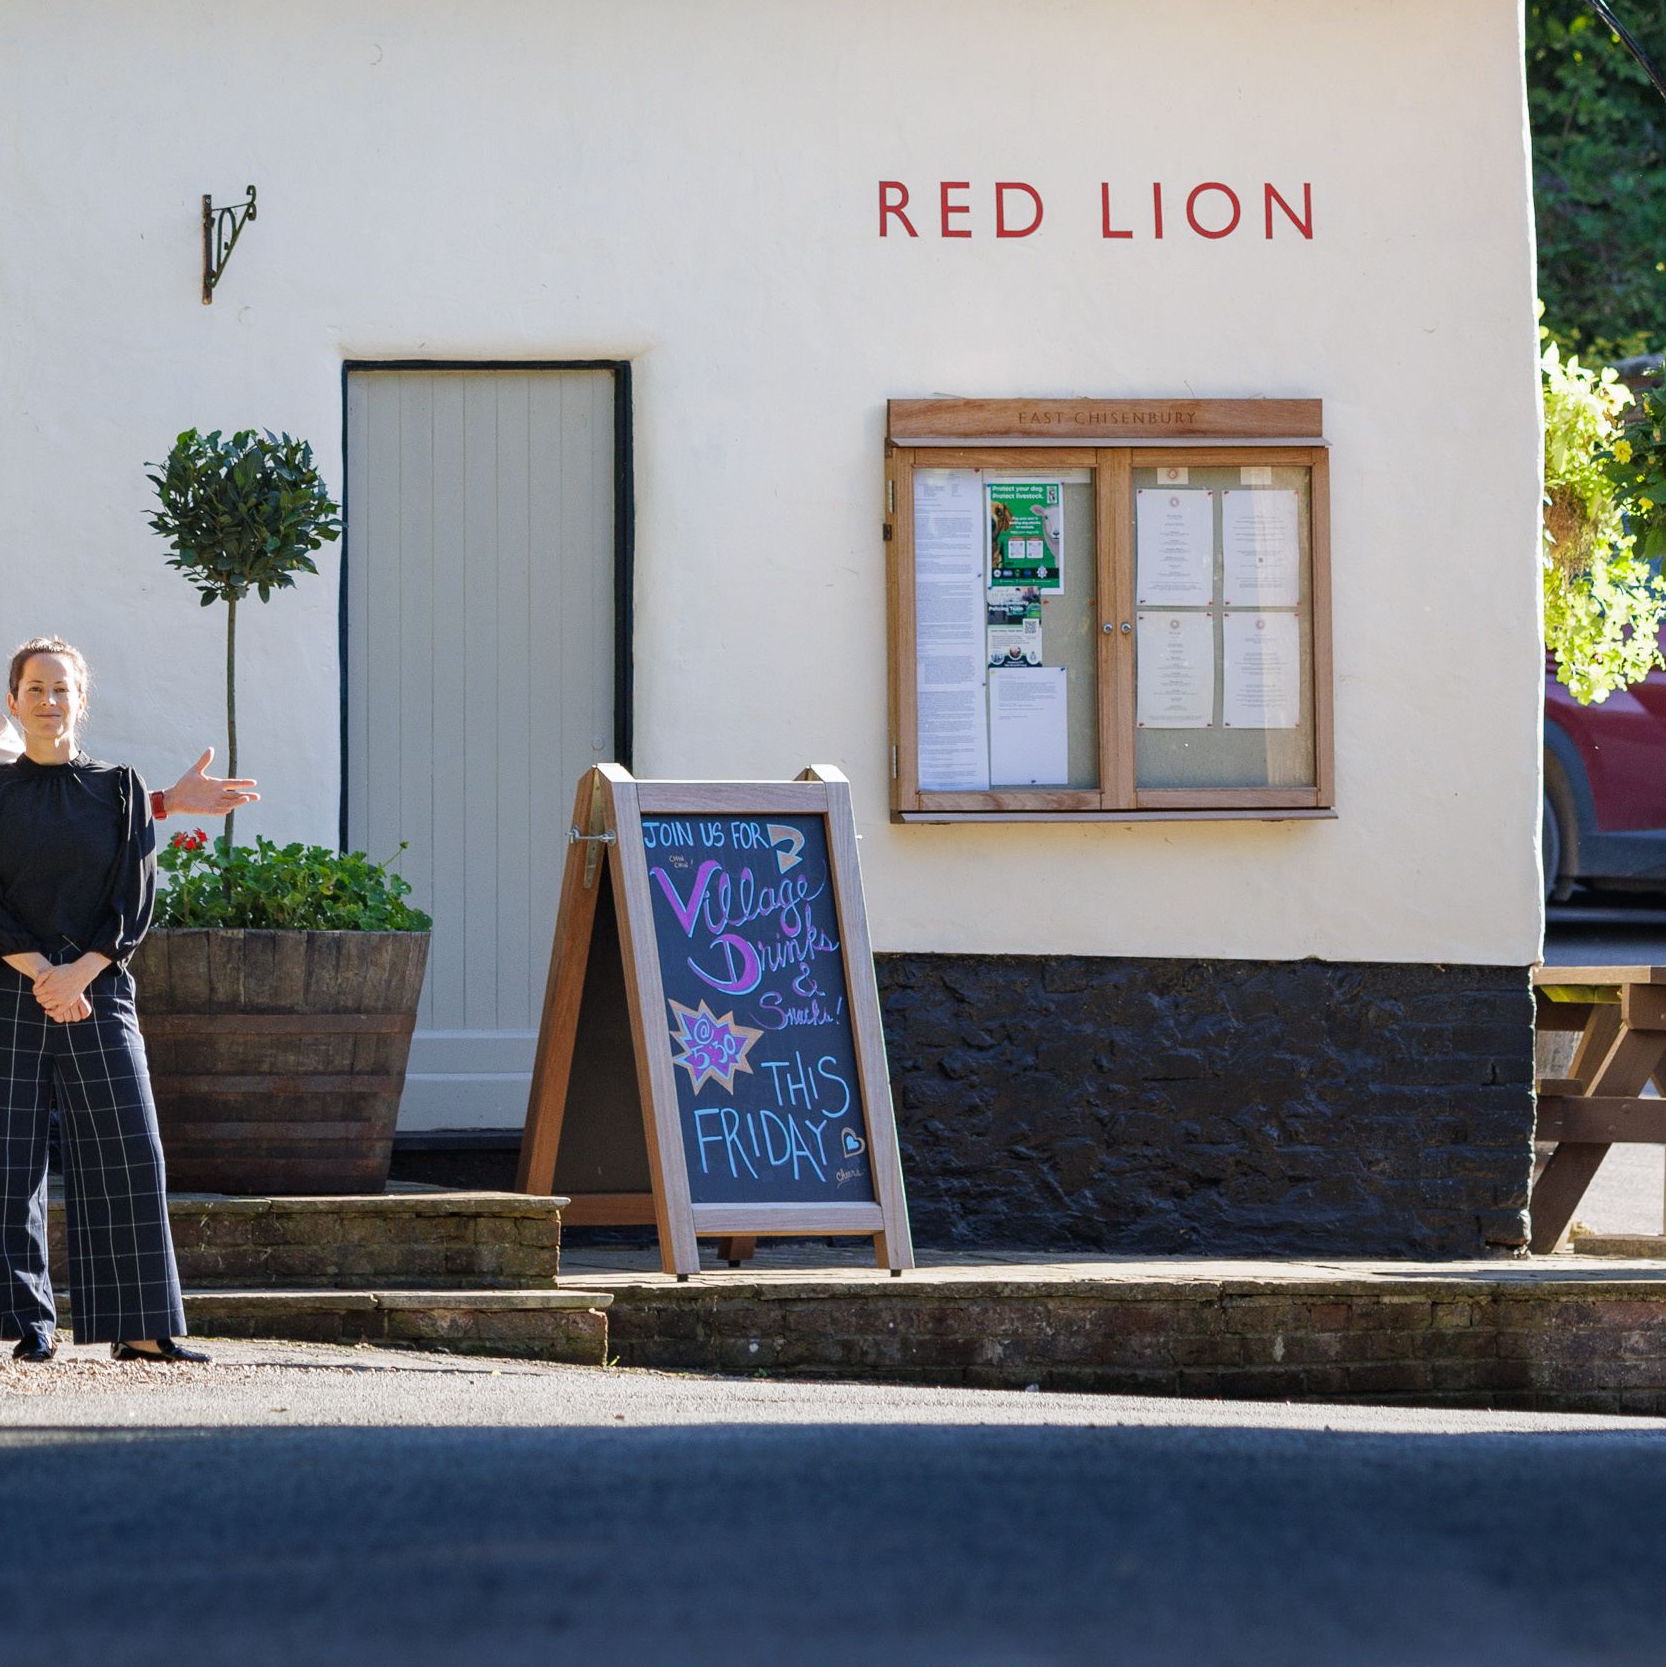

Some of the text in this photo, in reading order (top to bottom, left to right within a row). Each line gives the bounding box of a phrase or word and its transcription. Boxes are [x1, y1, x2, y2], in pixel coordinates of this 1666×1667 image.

[878, 180, 1314, 241] RED LION
[1018, 411, 1198, 426] EAST CHISENBURY
[642, 821, 770, 850] JOIN US FOR
[649, 859, 828, 939] Village
[687, 903, 840, 996] Drinks
[792, 962, 826, 998] &
[693, 1019, 715, 1045] @
[749, 990, 843, 1030] Snacks!
[760, 1050, 851, 1119] THIS
[693, 1107, 828, 1183] FRIDAY
